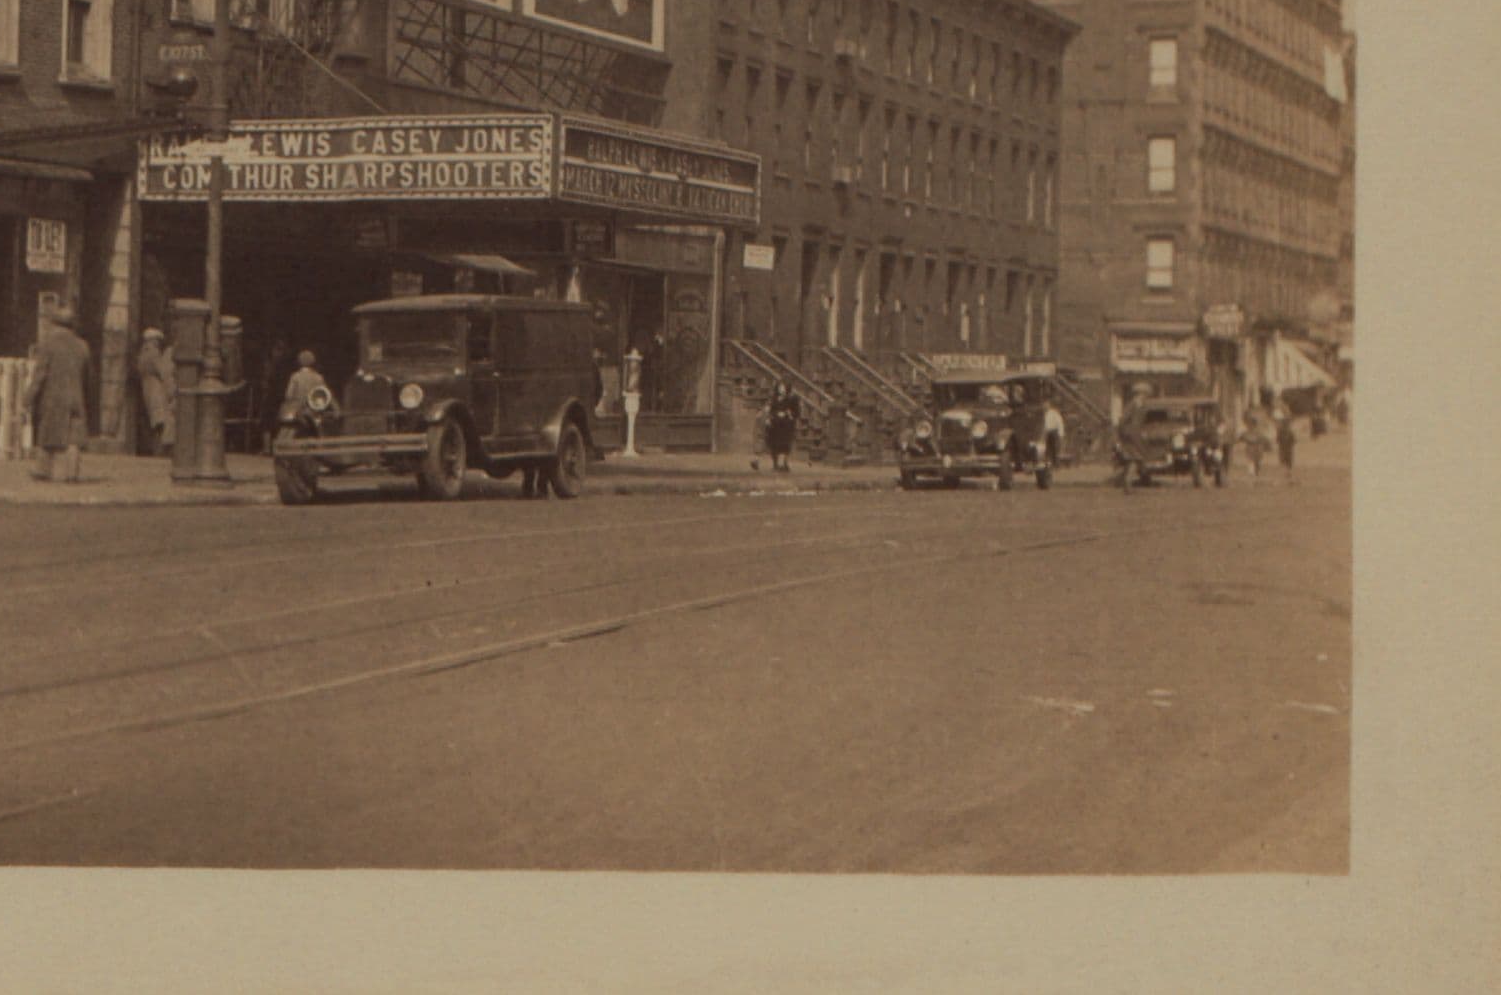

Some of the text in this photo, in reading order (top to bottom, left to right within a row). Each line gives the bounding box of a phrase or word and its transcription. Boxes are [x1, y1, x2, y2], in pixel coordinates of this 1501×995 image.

[245, 132, 331, 158] LEWIS
[352, 129, 442, 154] CASEY
[454, 127, 542, 153] JONES
[228, 163, 294, 190] THUR
[305, 160, 543, 190] SHARPSHOOTERS
